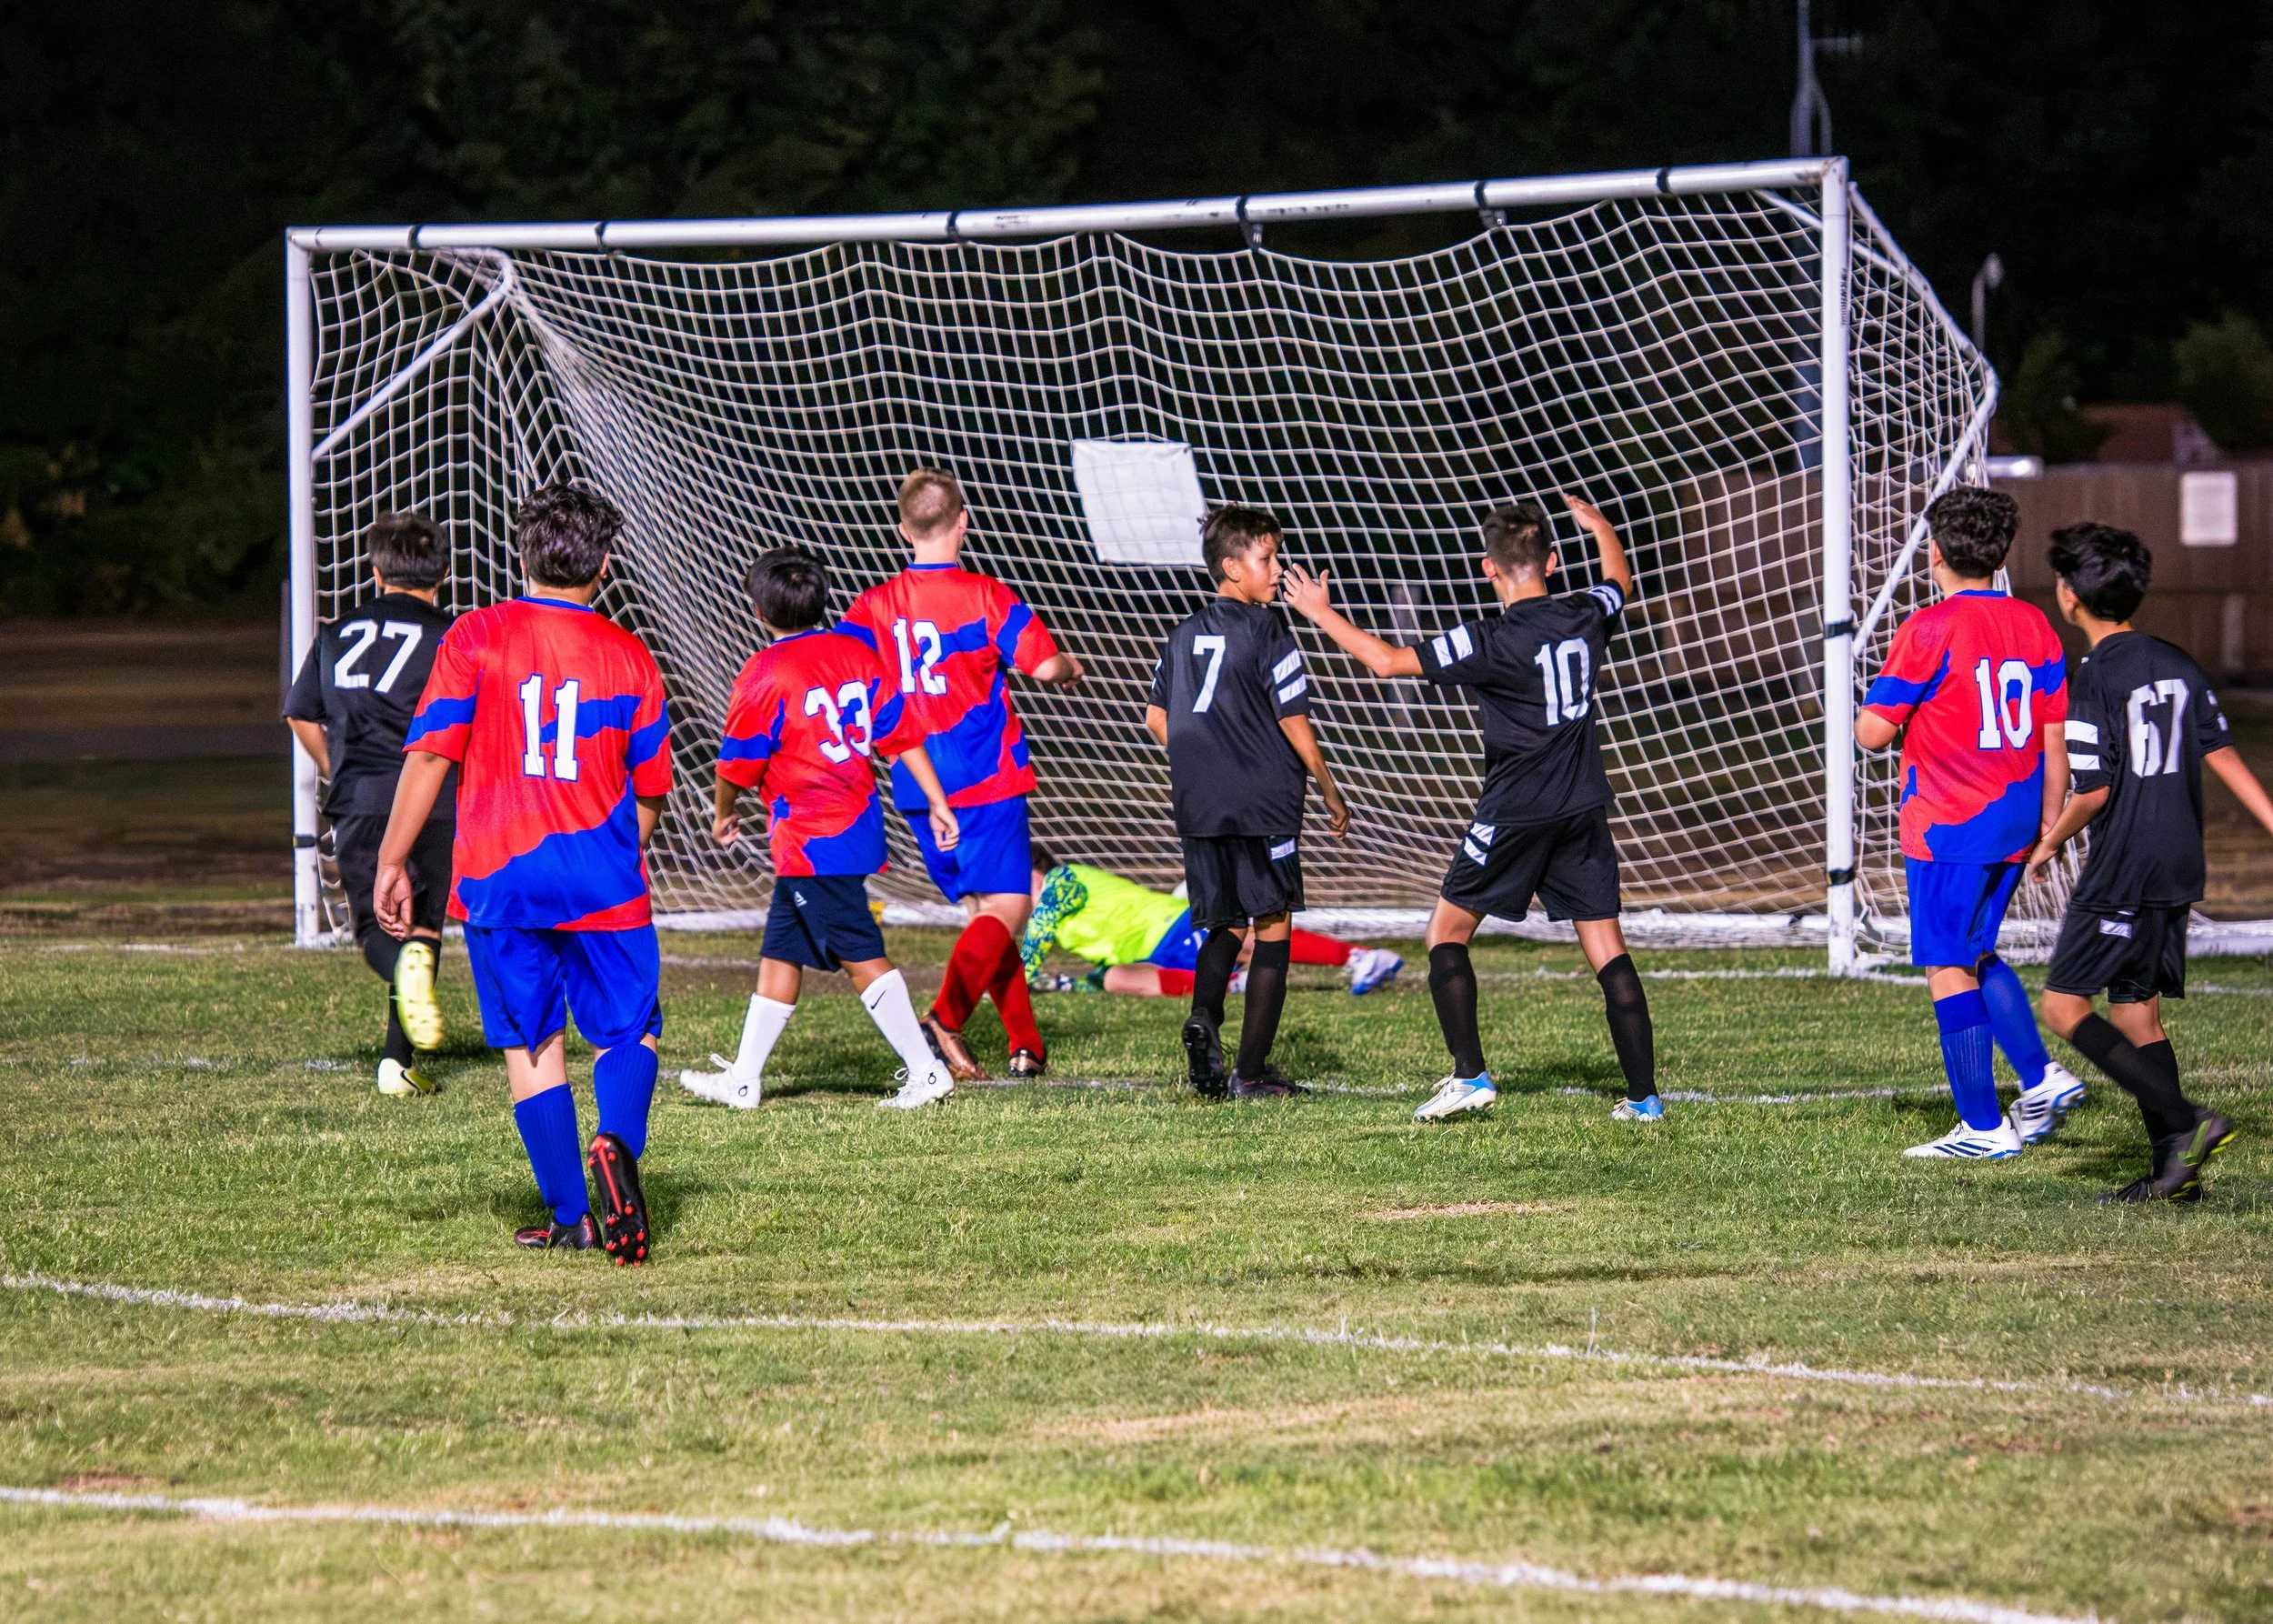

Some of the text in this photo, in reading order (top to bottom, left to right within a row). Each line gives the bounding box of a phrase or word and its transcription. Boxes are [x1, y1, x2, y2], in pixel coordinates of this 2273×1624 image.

[335, 618, 423, 694] 27
[892, 617, 947, 696] 12
[1192, 635, 1227, 713] 7
[1534, 637, 1590, 726] 10
[519, 673, 579, 782] 11
[804, 679, 873, 764] 33
[1974, 657, 2034, 750] 10
[2127, 678, 2189, 778] 67
